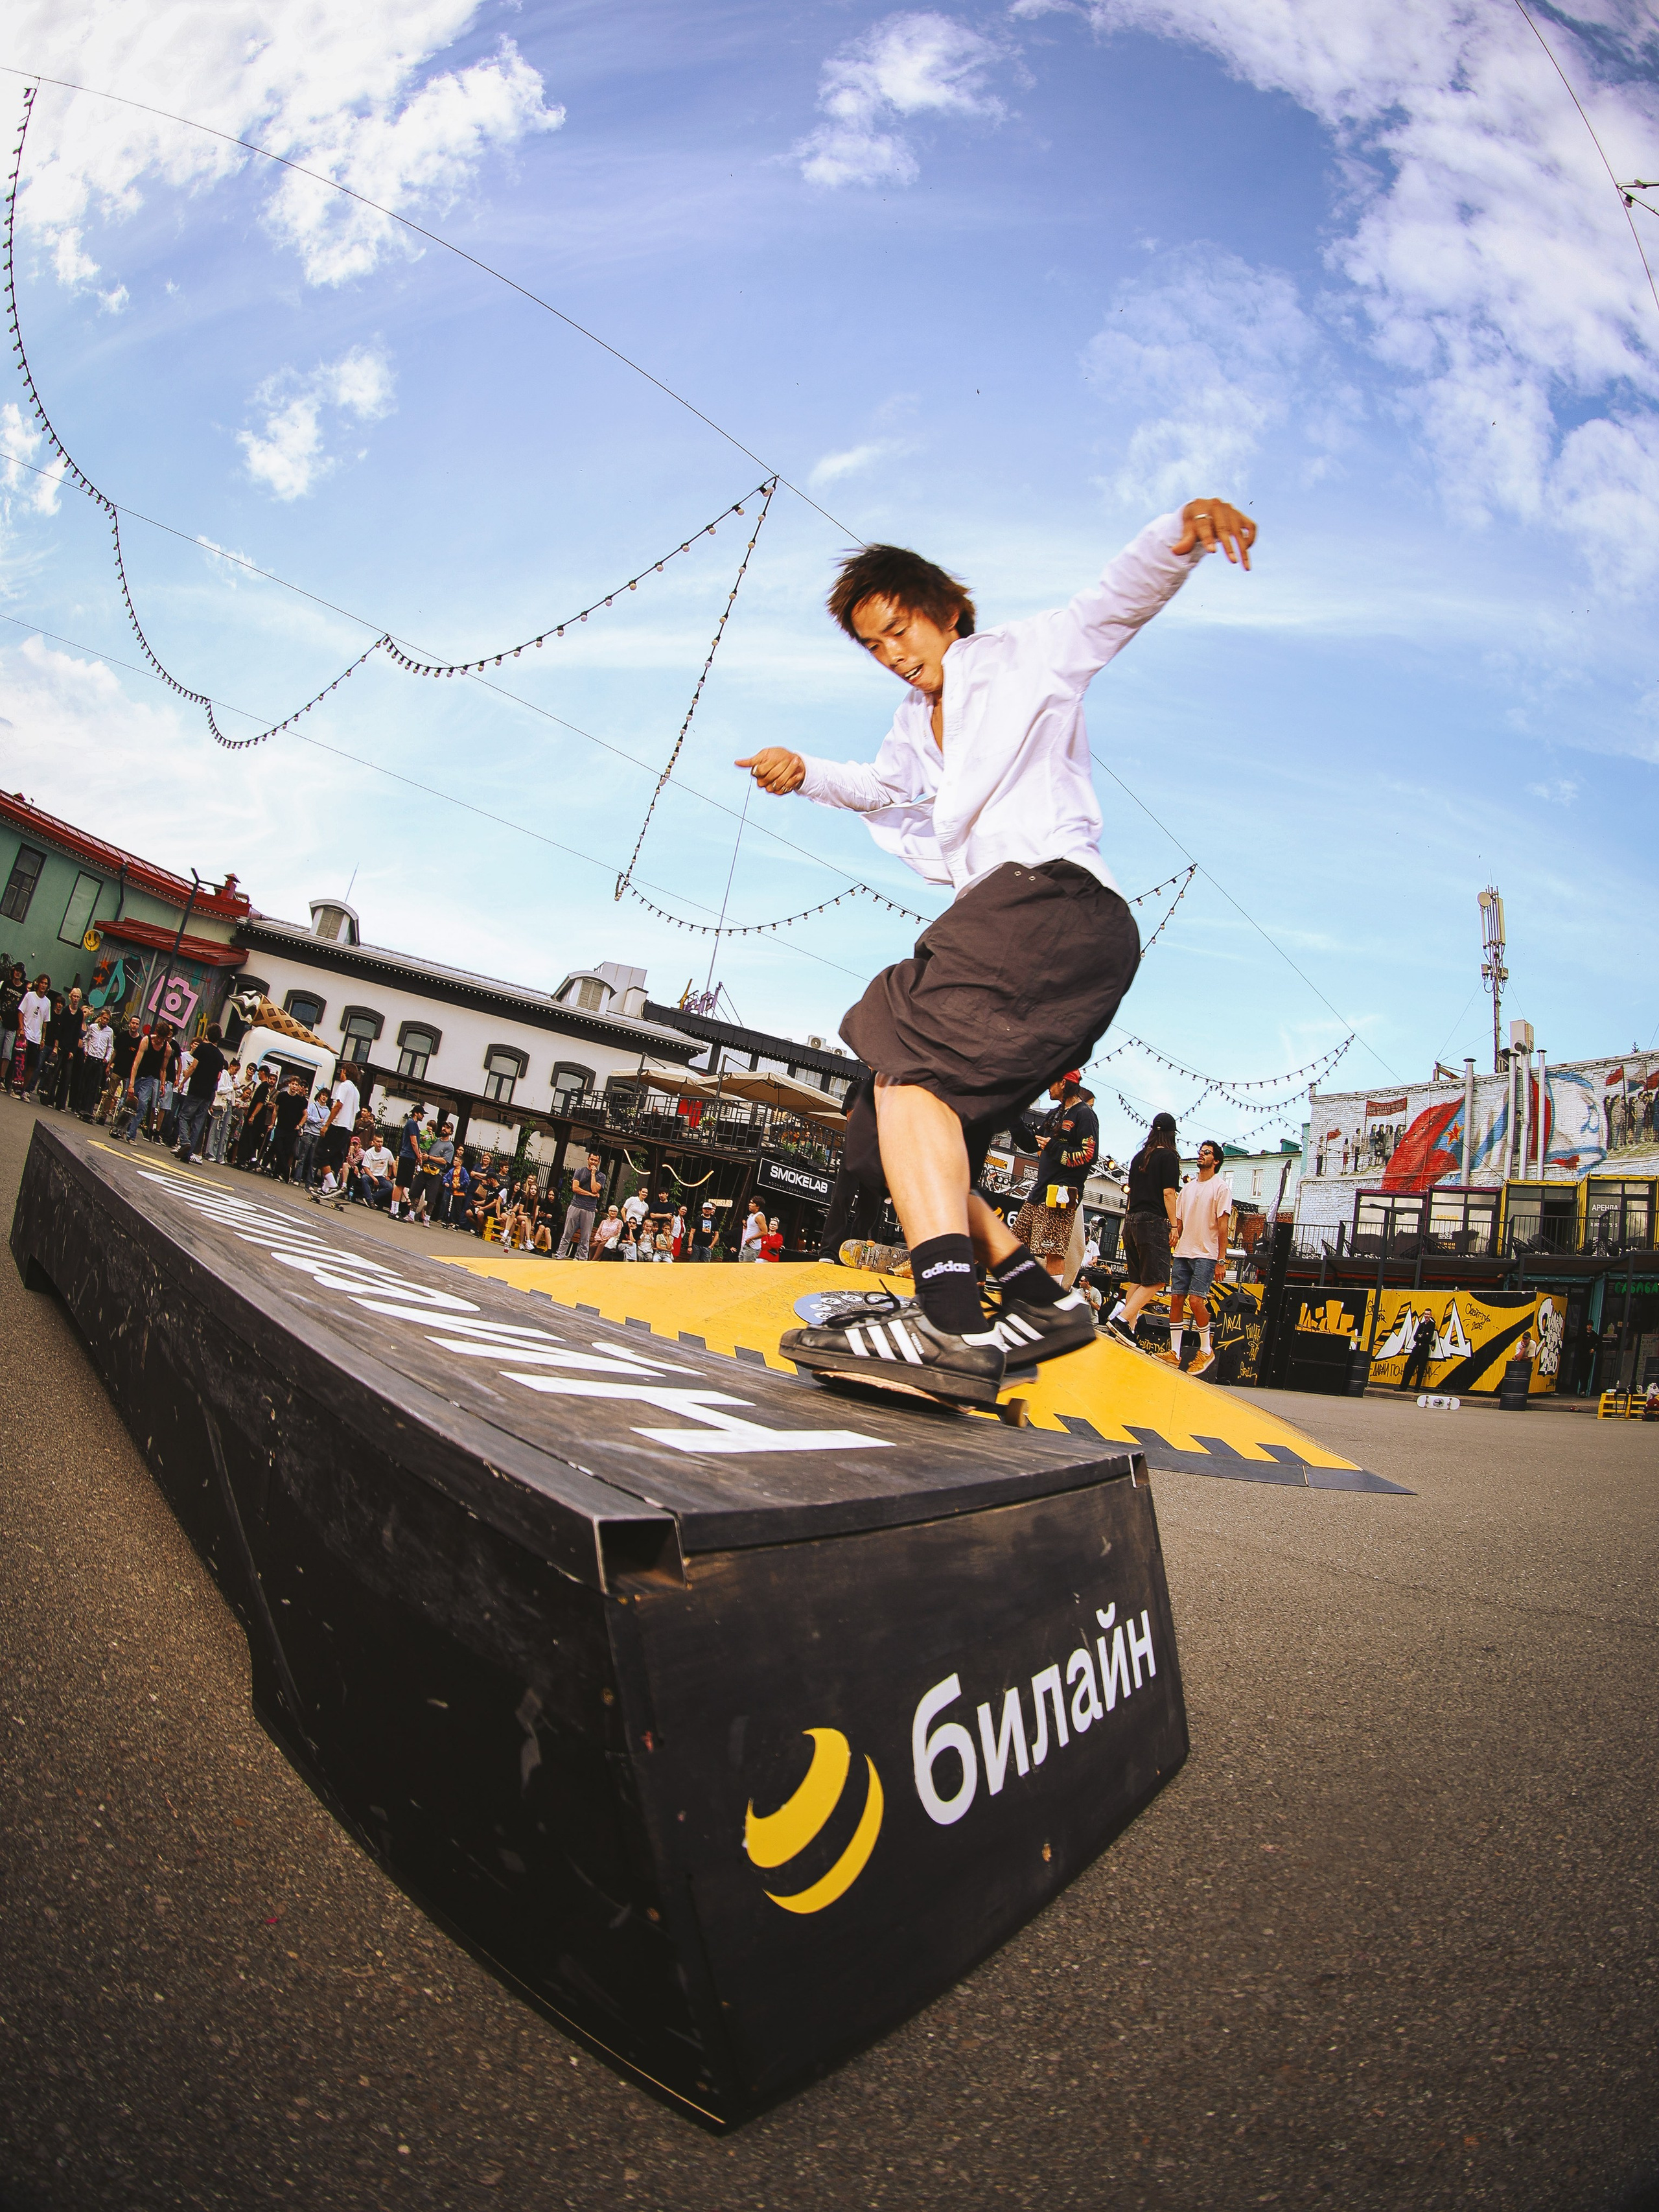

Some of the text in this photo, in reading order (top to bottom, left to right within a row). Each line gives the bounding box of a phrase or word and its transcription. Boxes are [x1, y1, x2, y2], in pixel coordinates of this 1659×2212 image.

[770, 1165, 828, 1194] SMOKELAB
[922, 1260, 971, 1279] adidas
[912, 1602, 1157, 1825] билайн
